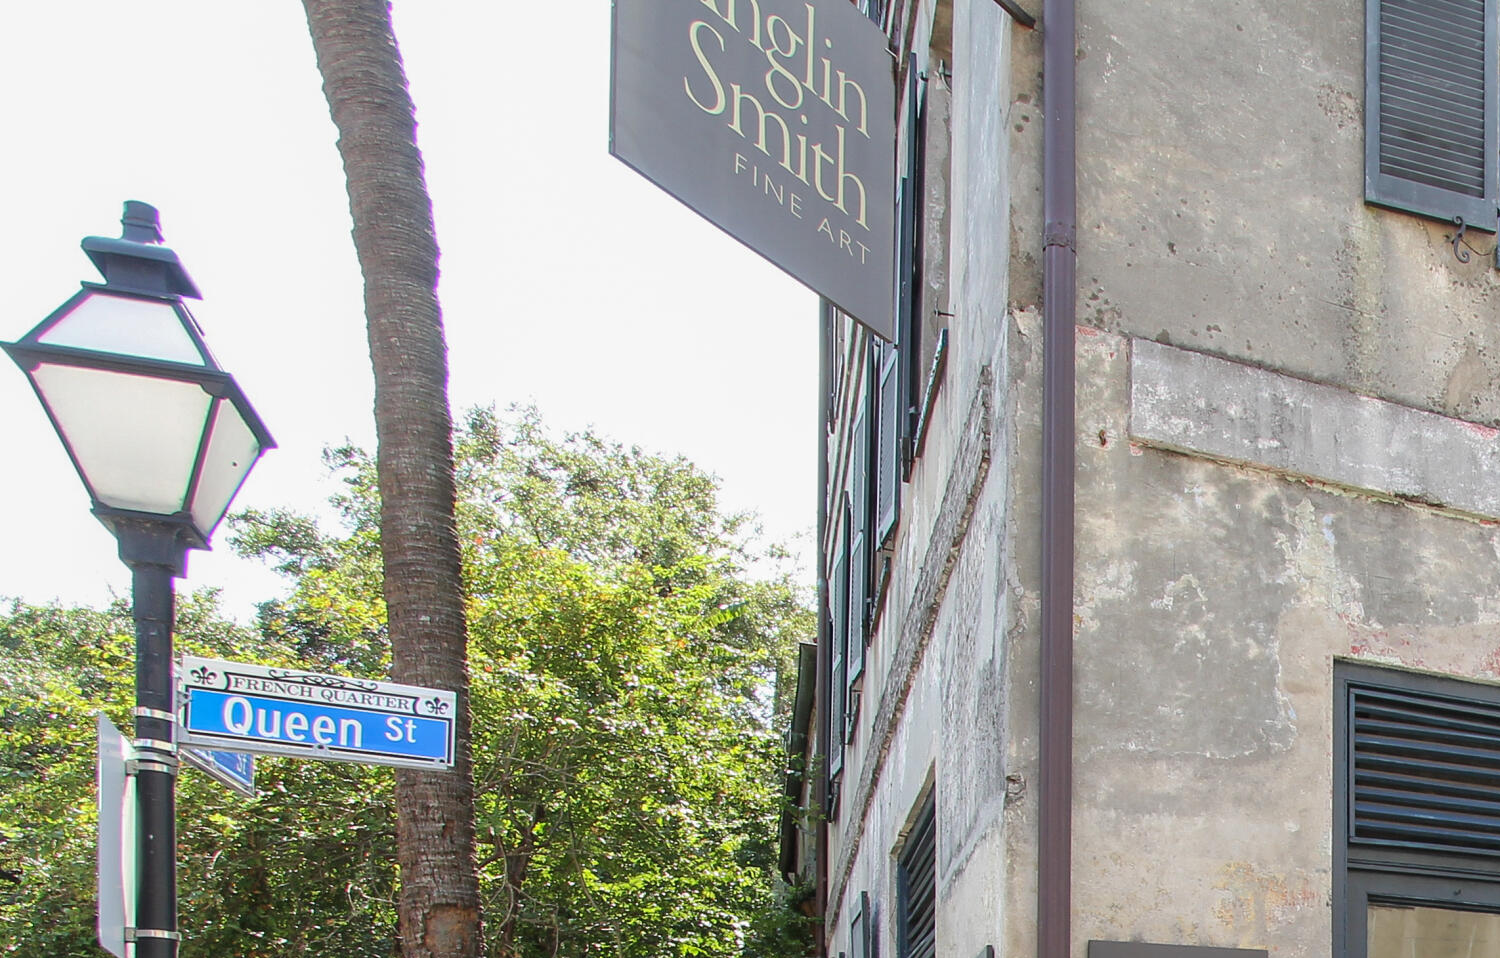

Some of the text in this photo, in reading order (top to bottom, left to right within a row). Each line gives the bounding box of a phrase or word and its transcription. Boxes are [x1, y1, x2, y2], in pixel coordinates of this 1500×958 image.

[700, 0, 871, 139] nglin
[684, 20, 870, 231] Smith
[736, 153, 871, 264] FINE ART
[223, 696, 417, 748] Queen St
[231, 676, 410, 711] FRENCH QUARTER
